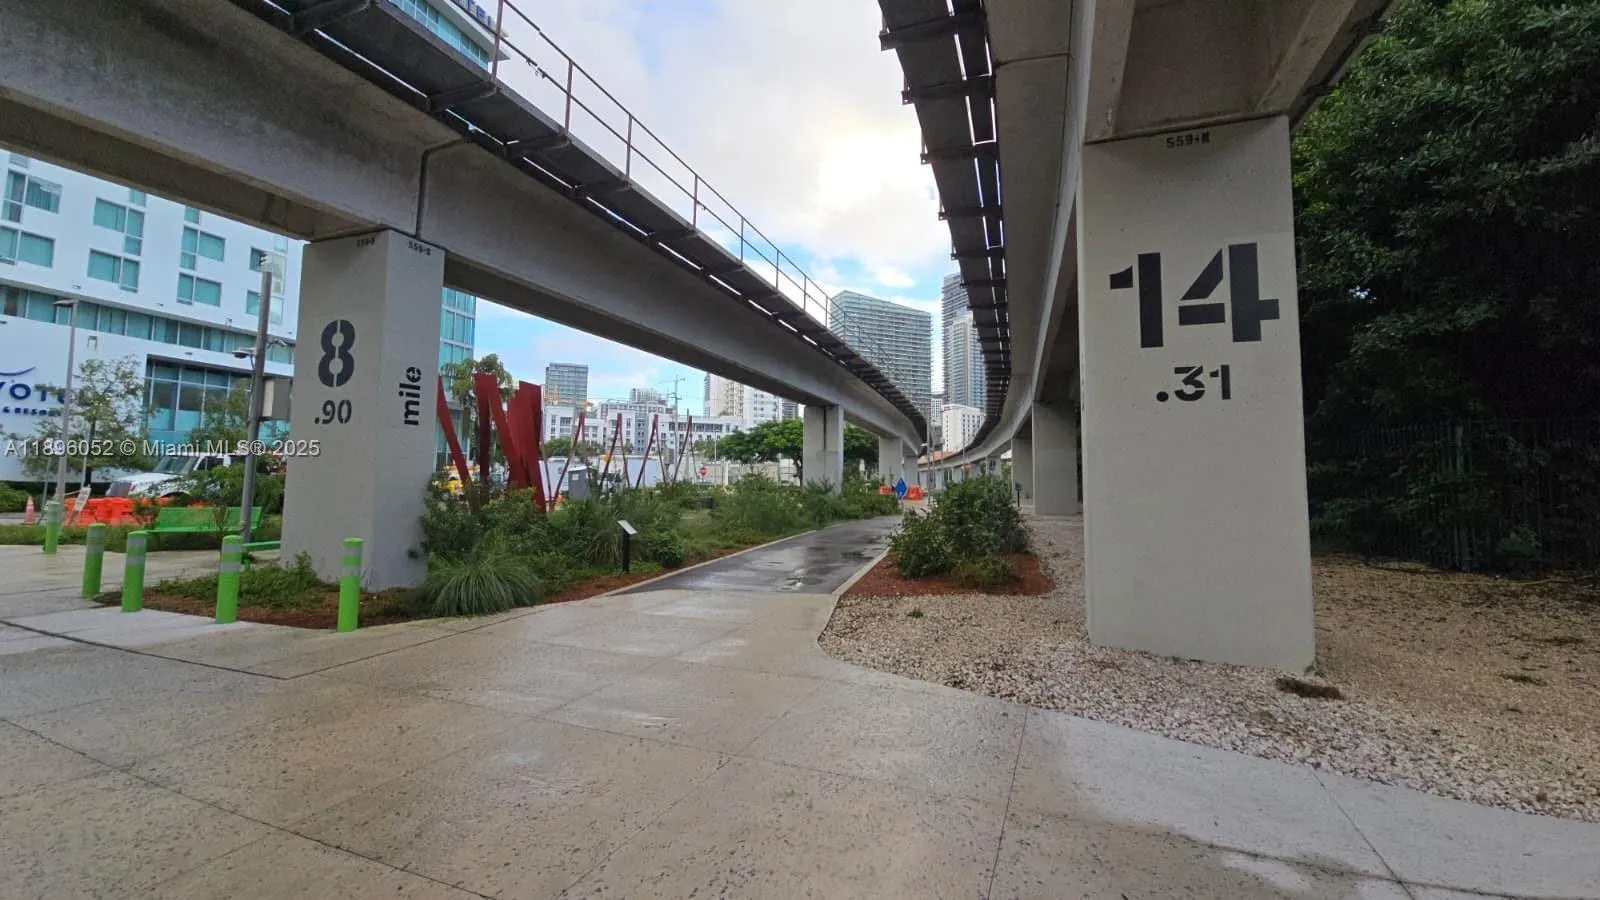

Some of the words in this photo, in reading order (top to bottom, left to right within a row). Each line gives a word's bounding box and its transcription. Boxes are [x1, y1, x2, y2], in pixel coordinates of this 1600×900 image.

[1109, 242, 1280, 348] 14
[318, 319, 356, 388] 8
[1156, 364, 1232, 402] .31
[314, 399, 352, 425] .90
[398, 366, 422, 426] mile
